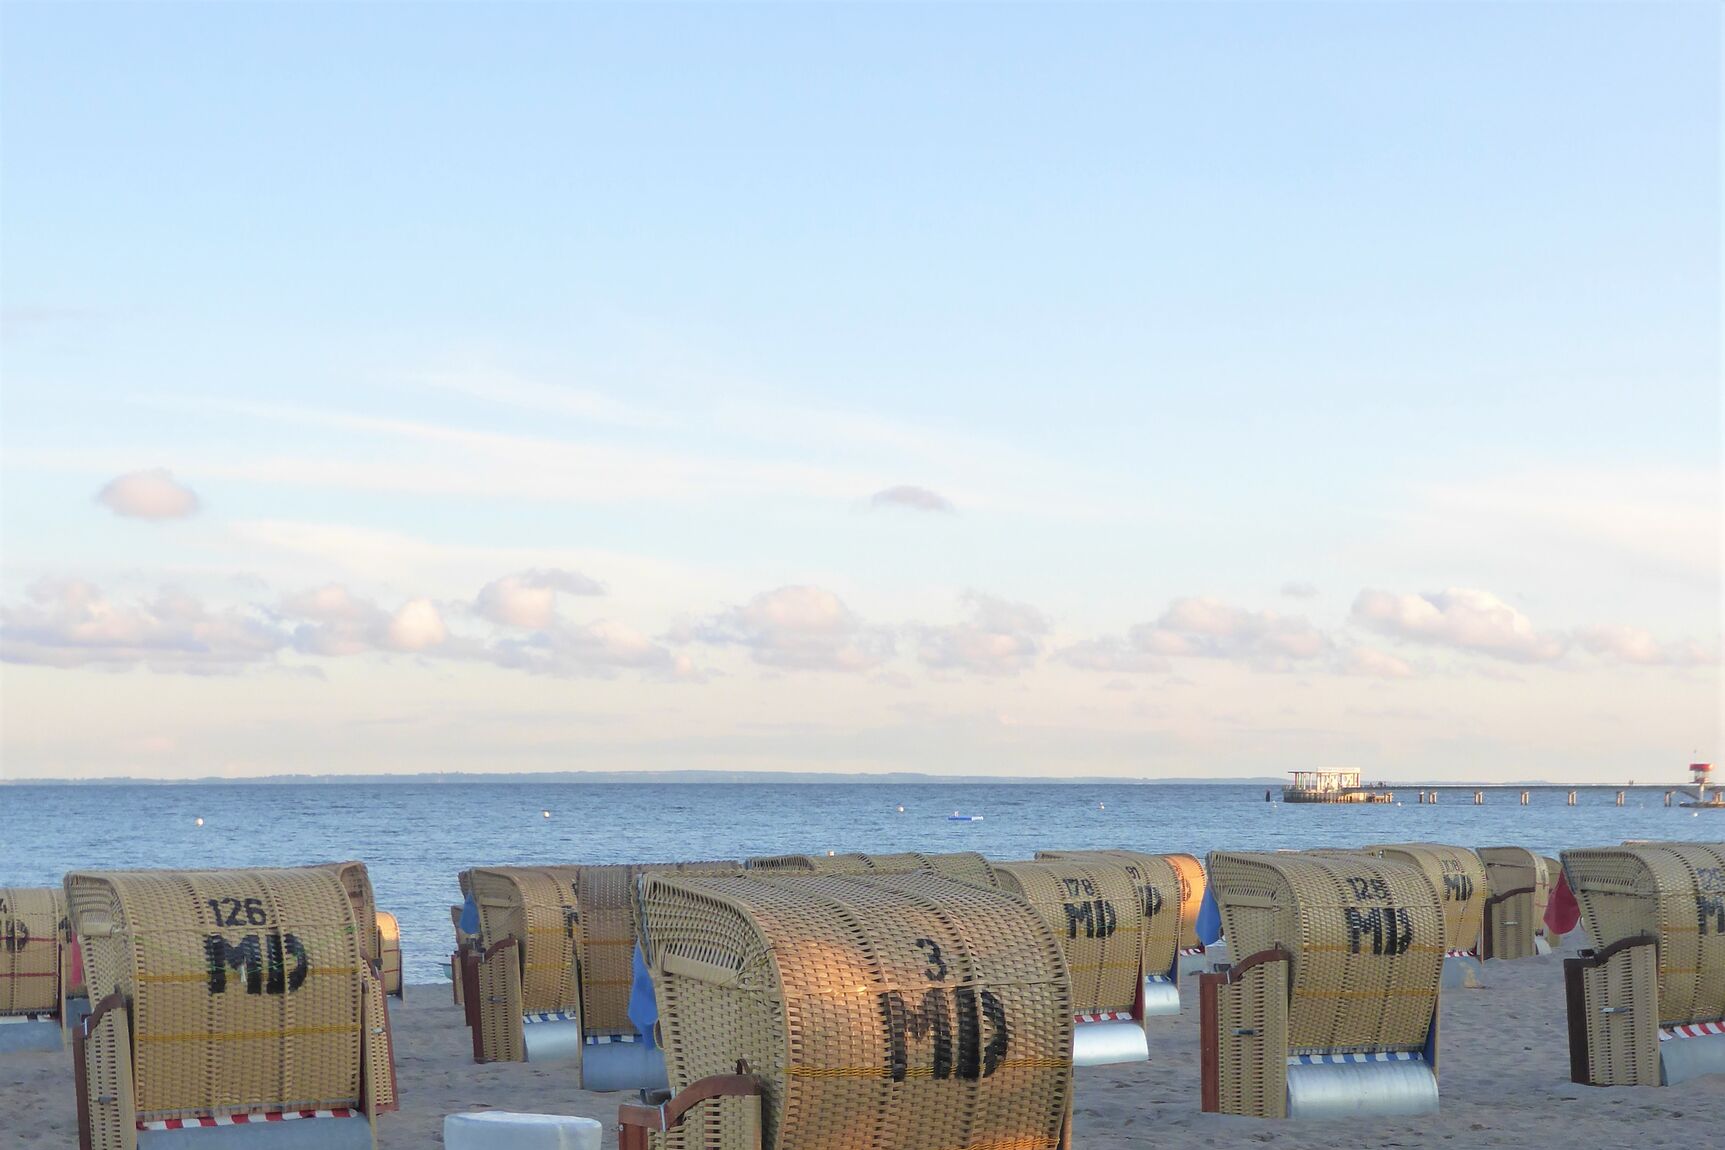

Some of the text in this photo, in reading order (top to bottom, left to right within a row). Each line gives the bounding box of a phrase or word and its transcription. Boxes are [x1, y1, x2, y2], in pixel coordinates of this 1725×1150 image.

[1443, 874, 1472, 901] MD
[208, 898, 267, 927] 126
[1064, 901, 1117, 938] MD
[1345, 907, 1413, 955] MD
[205, 933, 308, 995] MD
[915, 938, 948, 982] 3
[878, 987, 1008, 1081] MD
